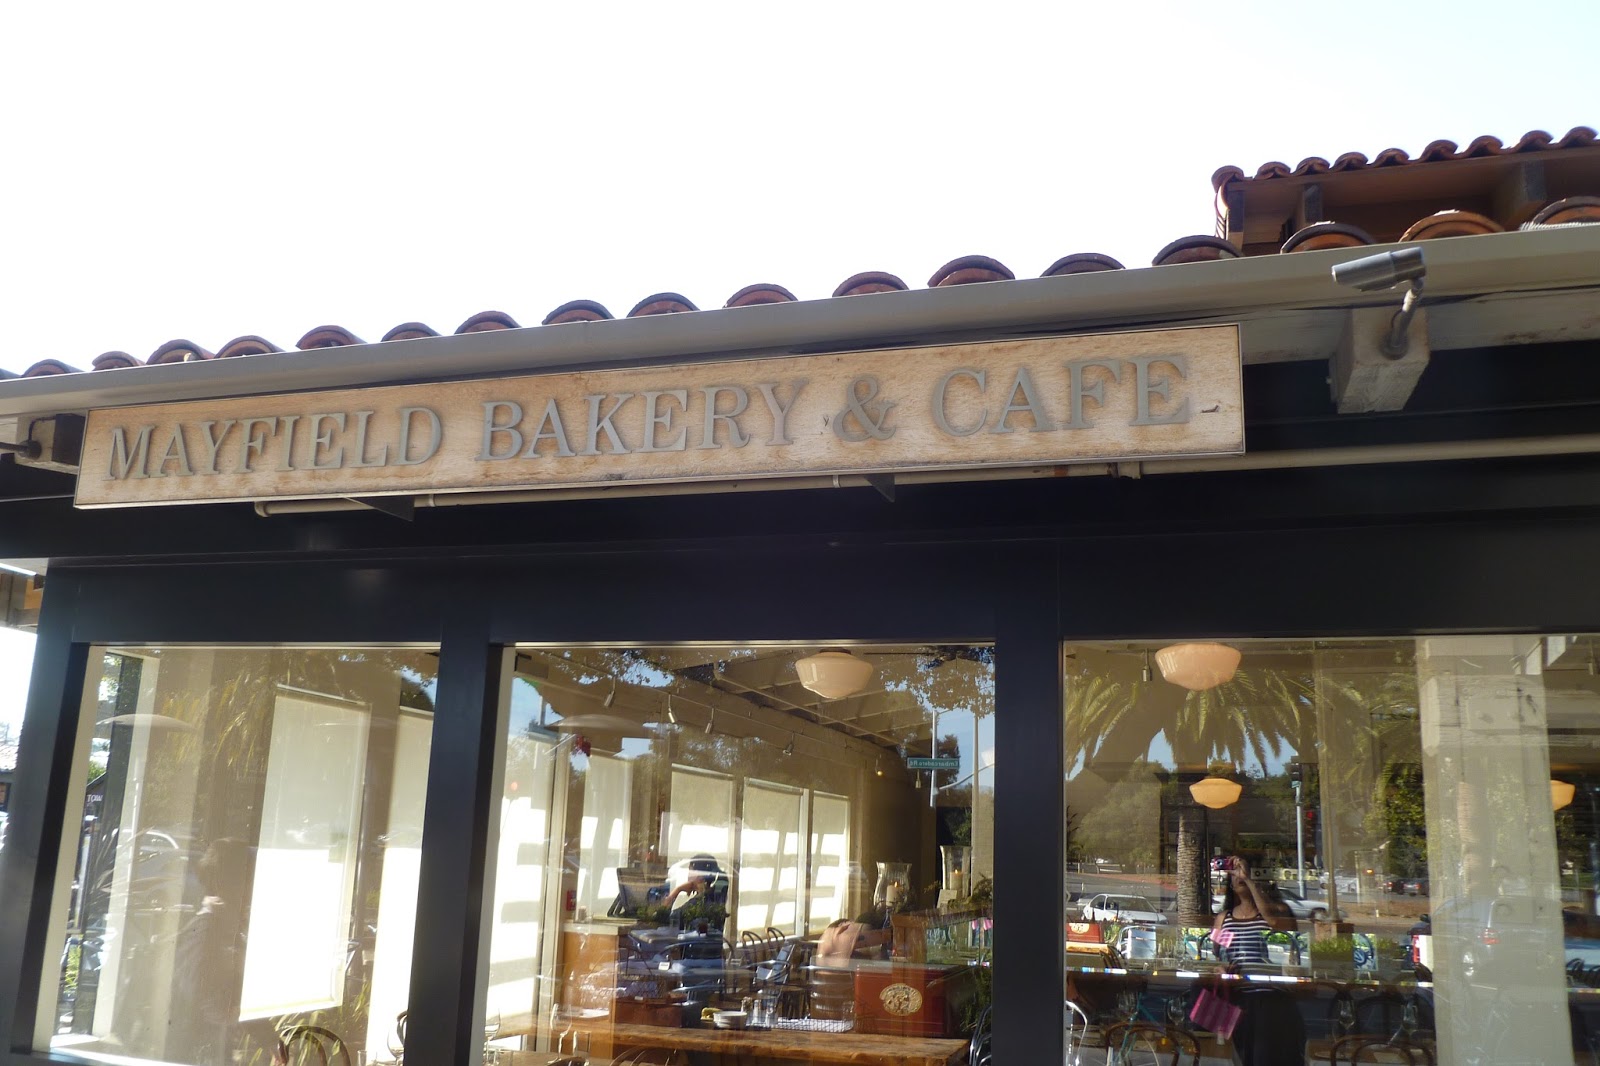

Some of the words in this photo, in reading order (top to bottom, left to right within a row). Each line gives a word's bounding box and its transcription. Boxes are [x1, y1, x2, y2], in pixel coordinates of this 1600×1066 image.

[102, 406, 442, 482] MAYFIELD
[475, 378, 808, 461] BAKERY
[832, 374, 897, 442] &
[932, 353, 1191, 437] CAFE
